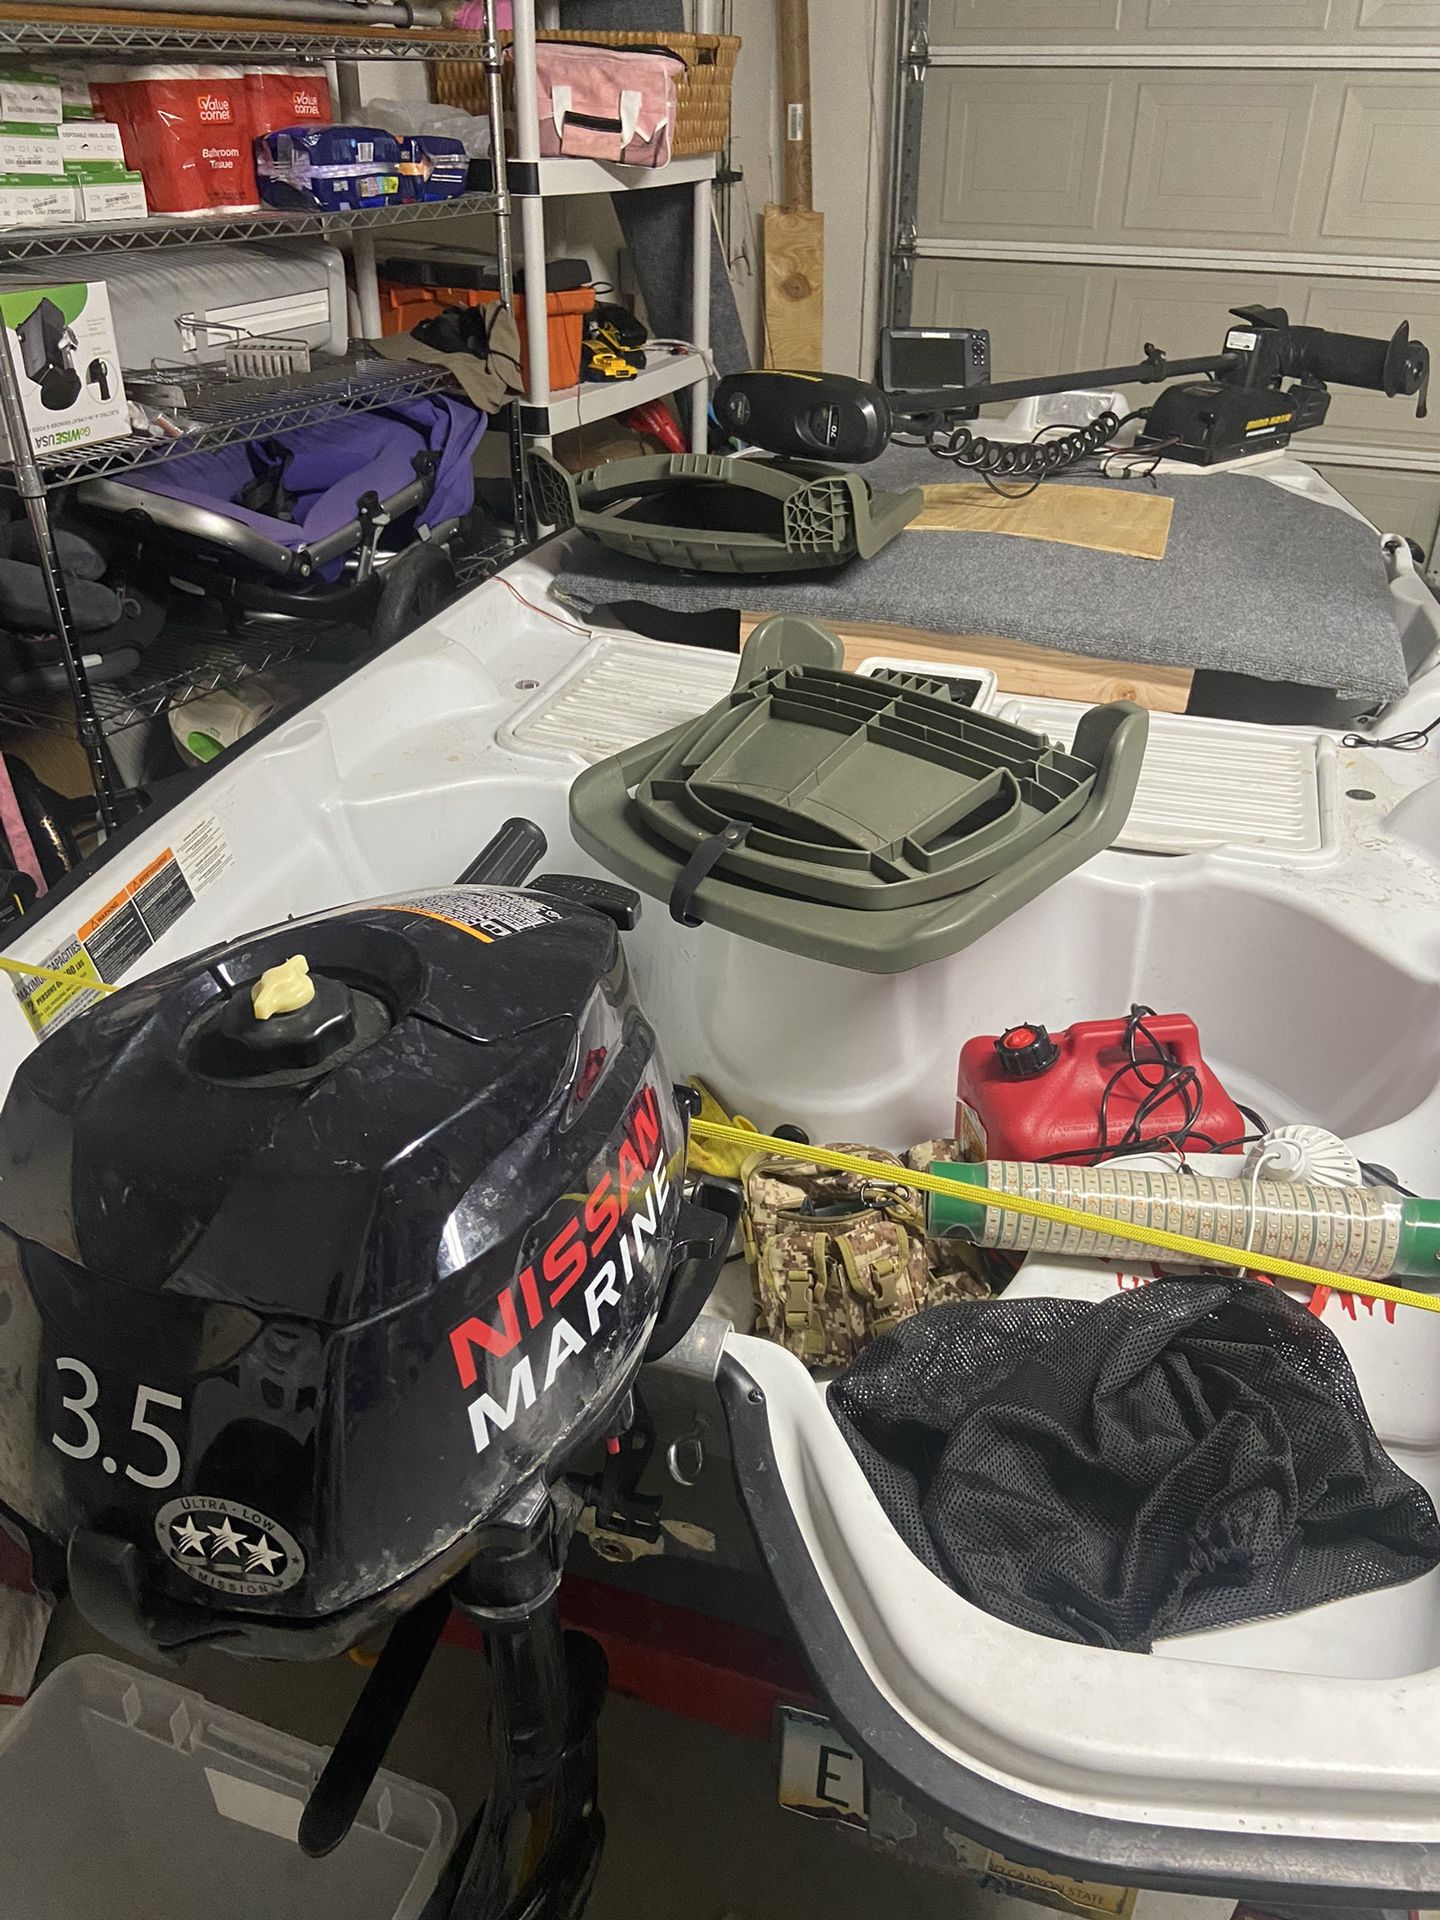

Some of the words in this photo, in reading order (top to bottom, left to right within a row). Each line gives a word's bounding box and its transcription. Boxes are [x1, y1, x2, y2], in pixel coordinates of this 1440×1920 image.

[201, 94, 230, 111] Value
[200, 110, 231, 121] corner
[202, 147, 240, 159] Bathroom
[209, 160, 234, 169] Tissue
[830, 425, 838, 438] 70
[449, 1087, 661, 1390] NISSAN
[466, 1148, 670, 1454] MARINE
[52, 1356, 183, 1490] 3.5
[180, 1497, 229, 1513] ULTRA
[242, 1507, 277, 1532] LOW
[816, 1744, 854, 1808] E
[1067, 1887, 1105, 1905] STATE
